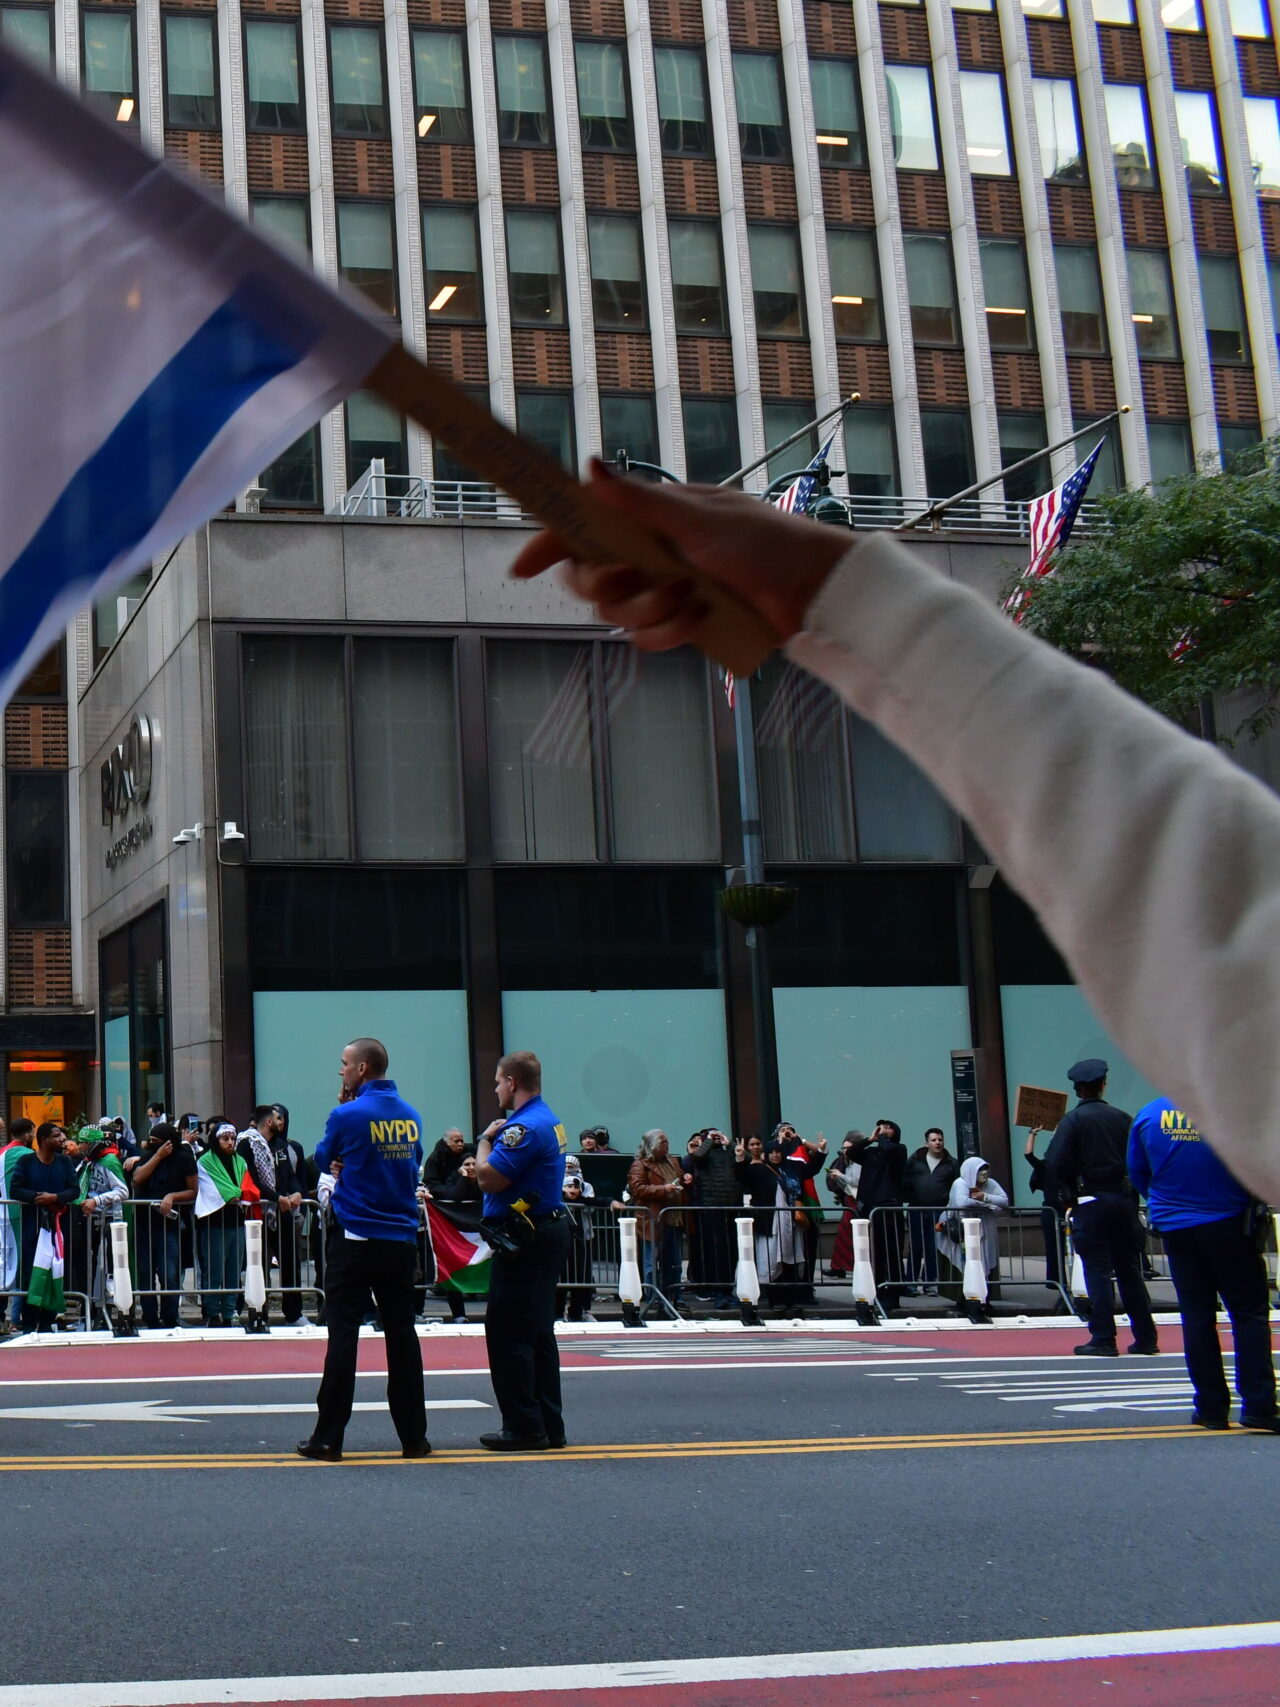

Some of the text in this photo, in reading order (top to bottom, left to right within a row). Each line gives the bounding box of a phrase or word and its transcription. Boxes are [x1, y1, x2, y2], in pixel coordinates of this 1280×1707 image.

[370, 1119, 419, 1144] NYPD
[377, 1144, 415, 1152] COMMUNITY
[383, 1152, 412, 1160] AFFAIRS
